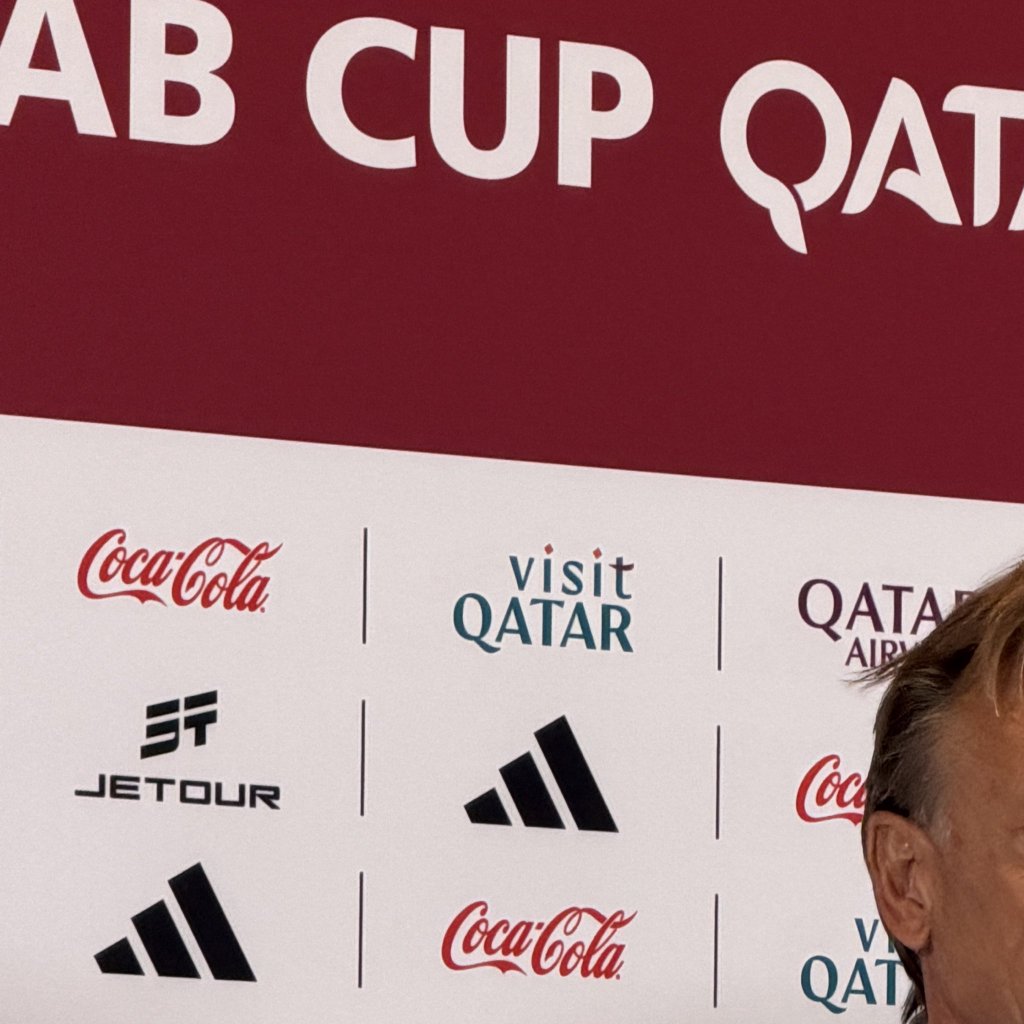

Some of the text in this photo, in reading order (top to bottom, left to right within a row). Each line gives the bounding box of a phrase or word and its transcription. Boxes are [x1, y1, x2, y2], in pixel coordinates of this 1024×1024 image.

[305, 16, 655, 189] CUP
[509, 543, 635, 600] visit
[453, 592, 635, 654] QATAR
[798, 578, 975, 642] QATA
[74, 773, 281, 811] JETOUR
